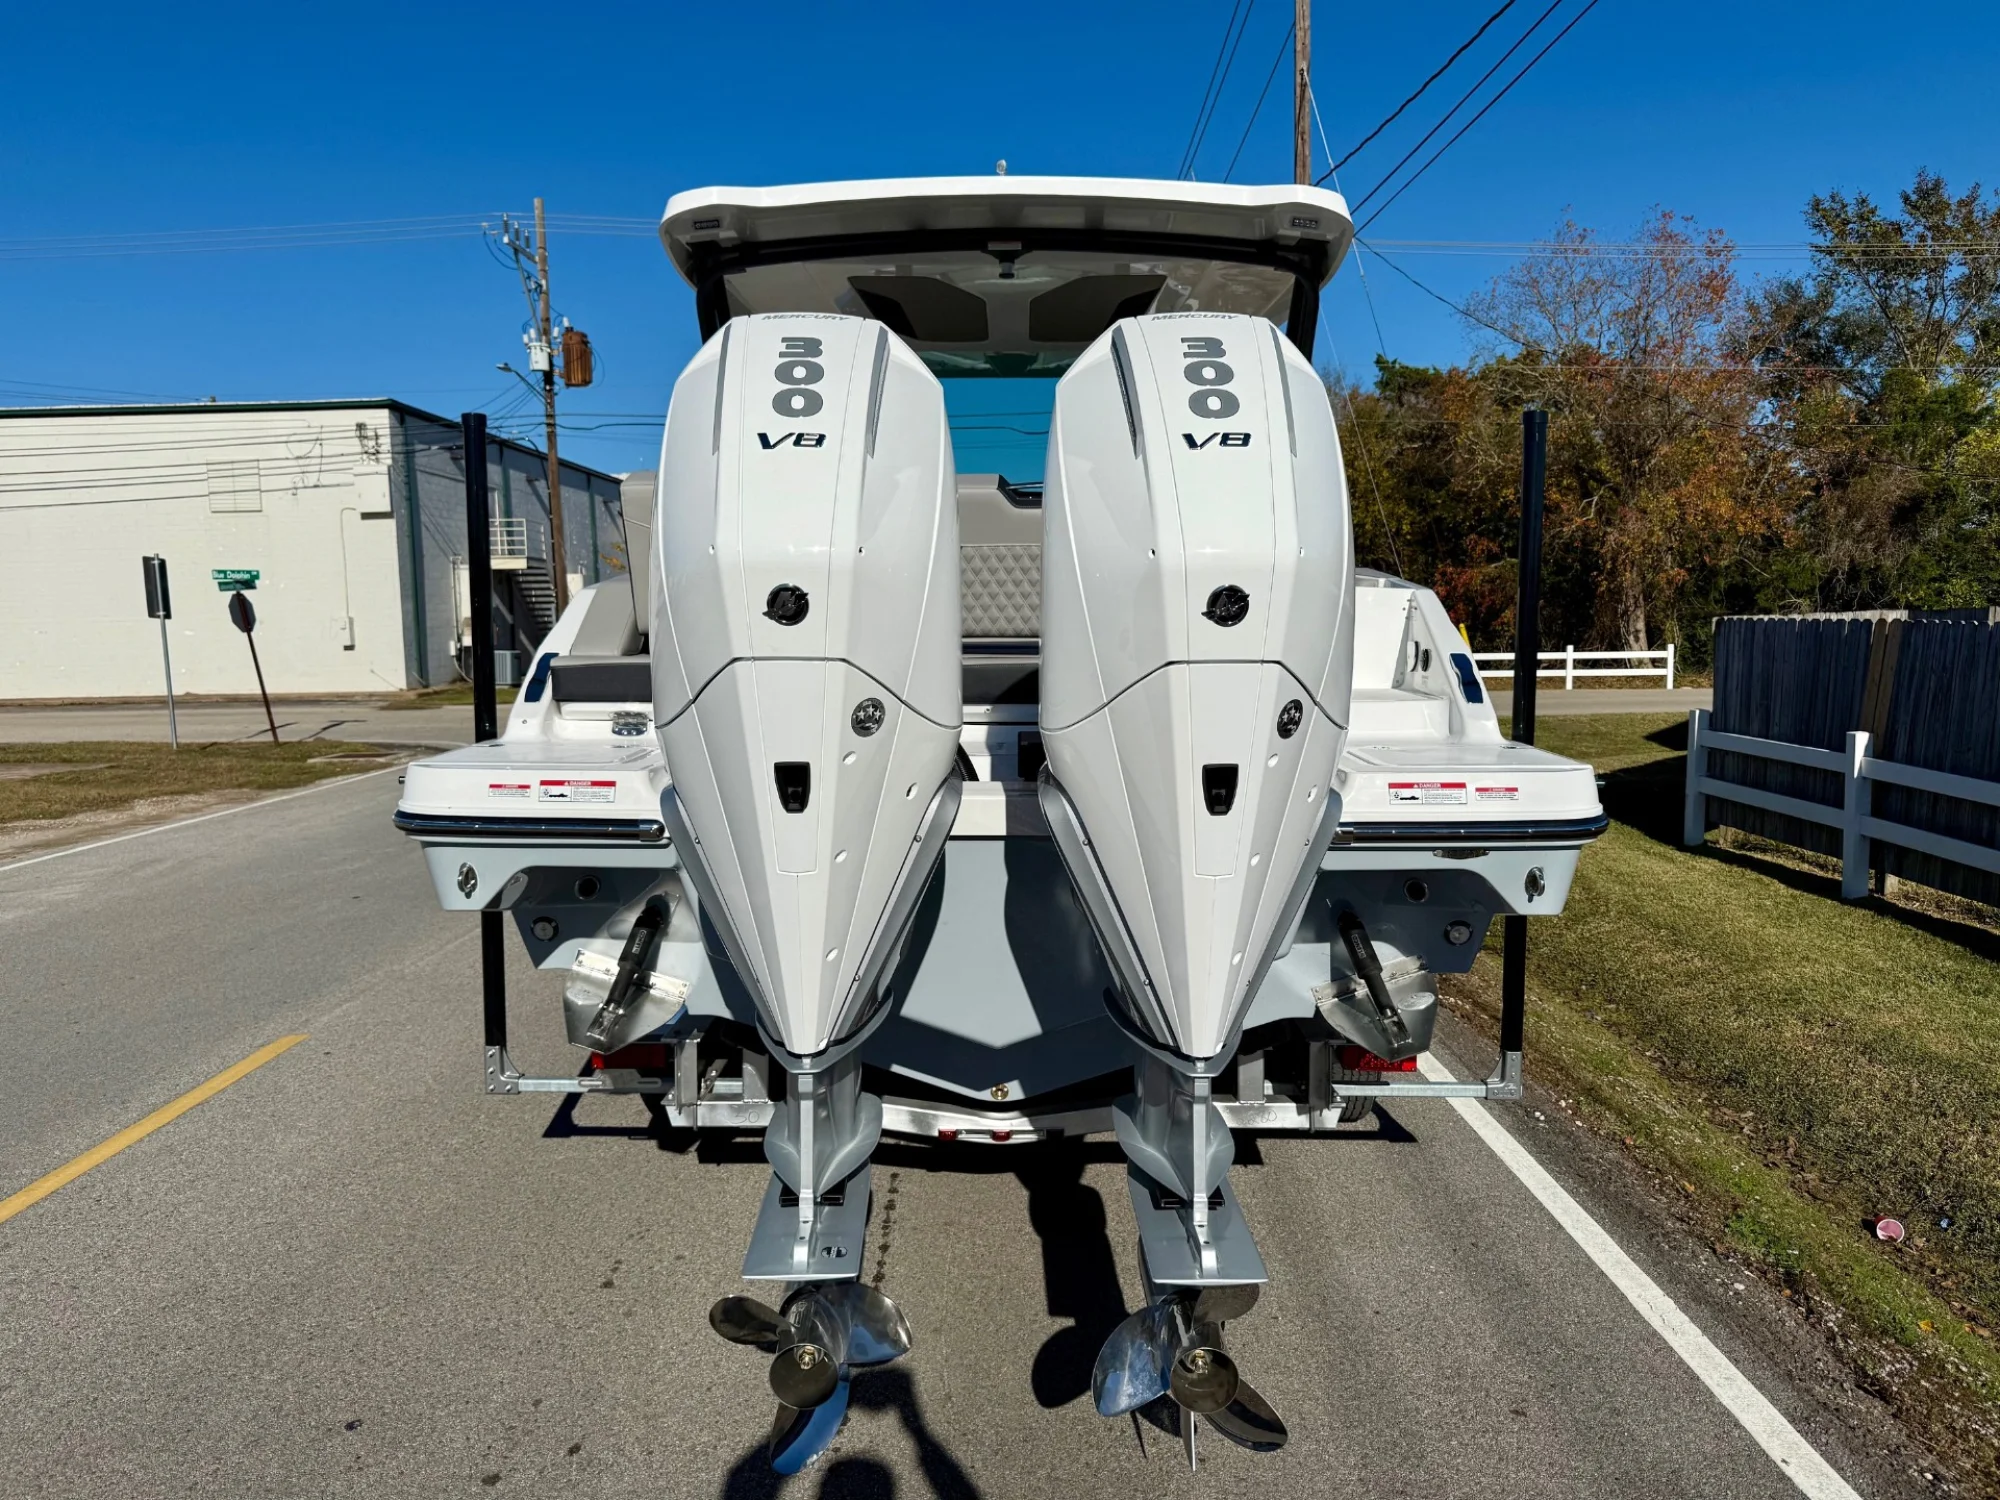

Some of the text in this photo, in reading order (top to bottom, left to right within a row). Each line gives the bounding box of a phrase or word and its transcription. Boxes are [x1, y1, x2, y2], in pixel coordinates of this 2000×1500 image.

[761, 313, 850, 321] MERCURY
[1151, 313, 1239, 321] MERCURY
[772, 336, 825, 418] 300
[1180, 336, 1241, 419] 300
[757, 432, 827, 450] V8
[1182, 432, 1252, 450] V8
[213, 570, 225, 579] Blue
[226, 570, 251, 580] Dolphin
